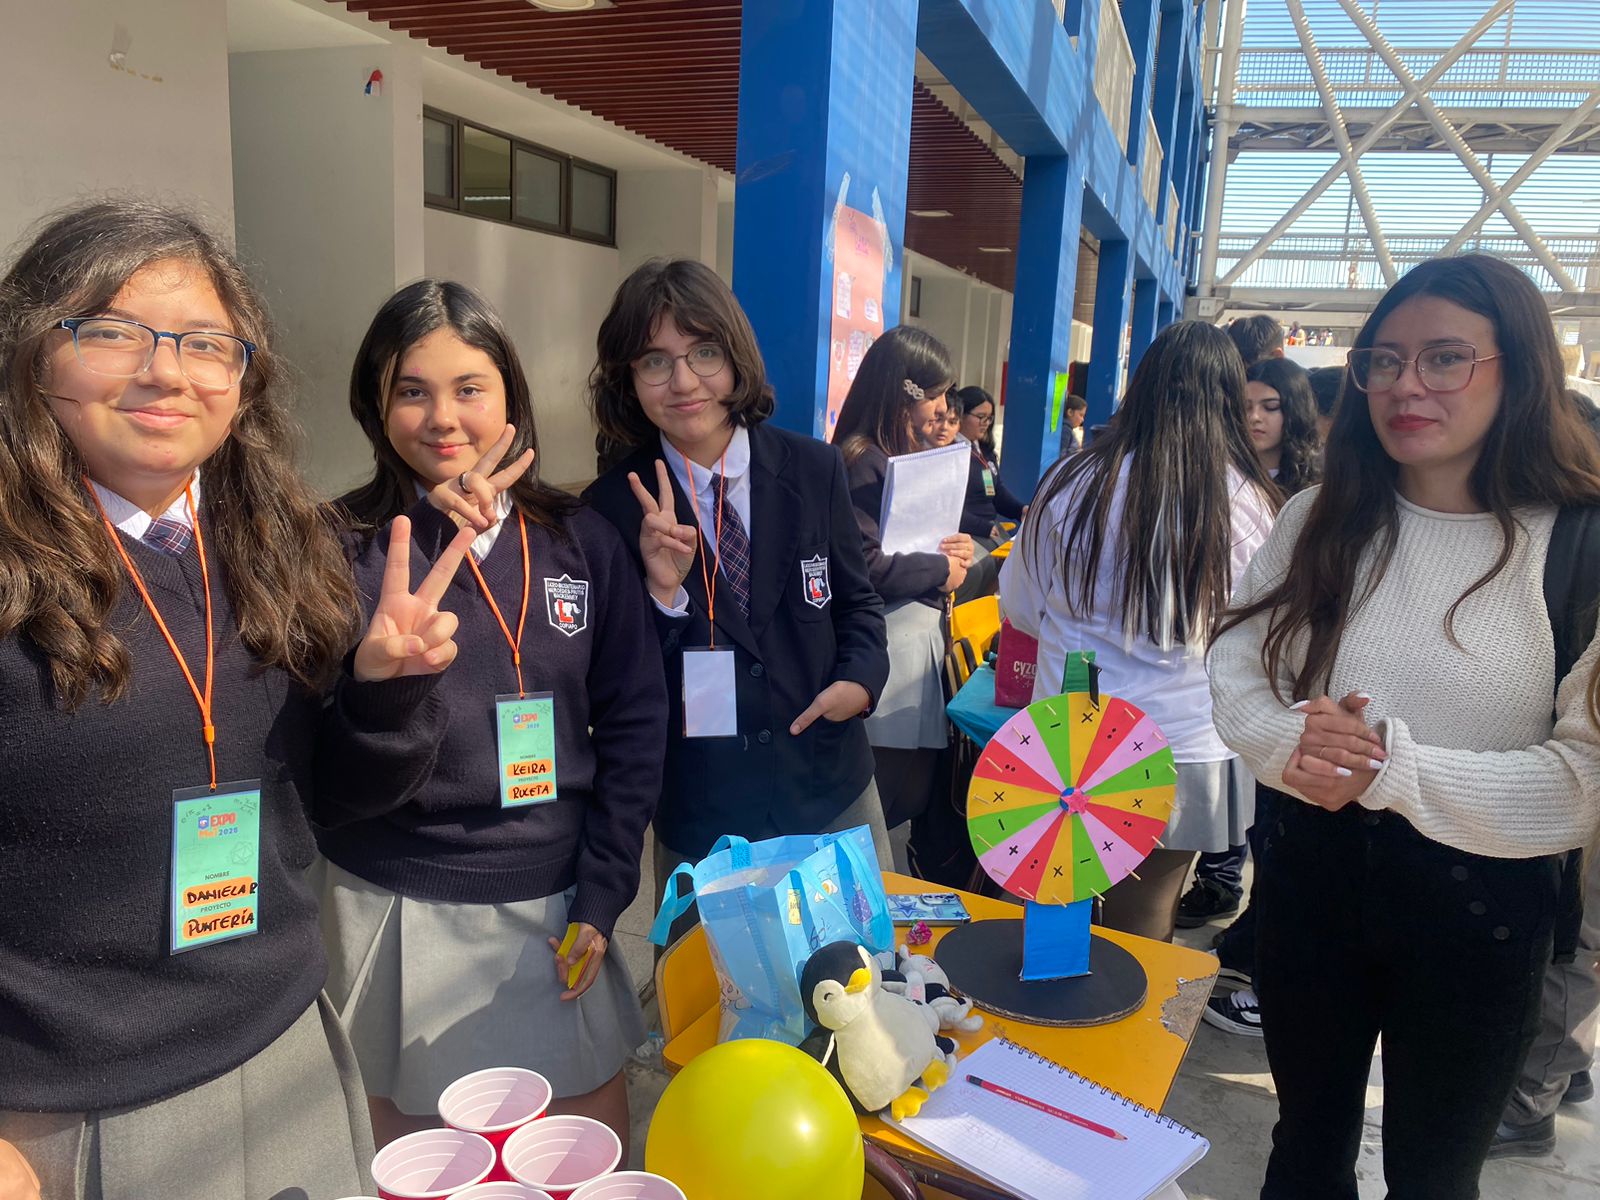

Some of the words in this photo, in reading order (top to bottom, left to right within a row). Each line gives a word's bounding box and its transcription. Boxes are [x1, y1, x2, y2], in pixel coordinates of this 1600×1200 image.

[513, 763, 546, 775] KEIRA
[210, 812, 237, 828] EXPO
[204, 871, 230, 880] NOMBRE
[187, 884, 246, 904] DANIELA
[200, 902, 231, 913] PROYECTO
